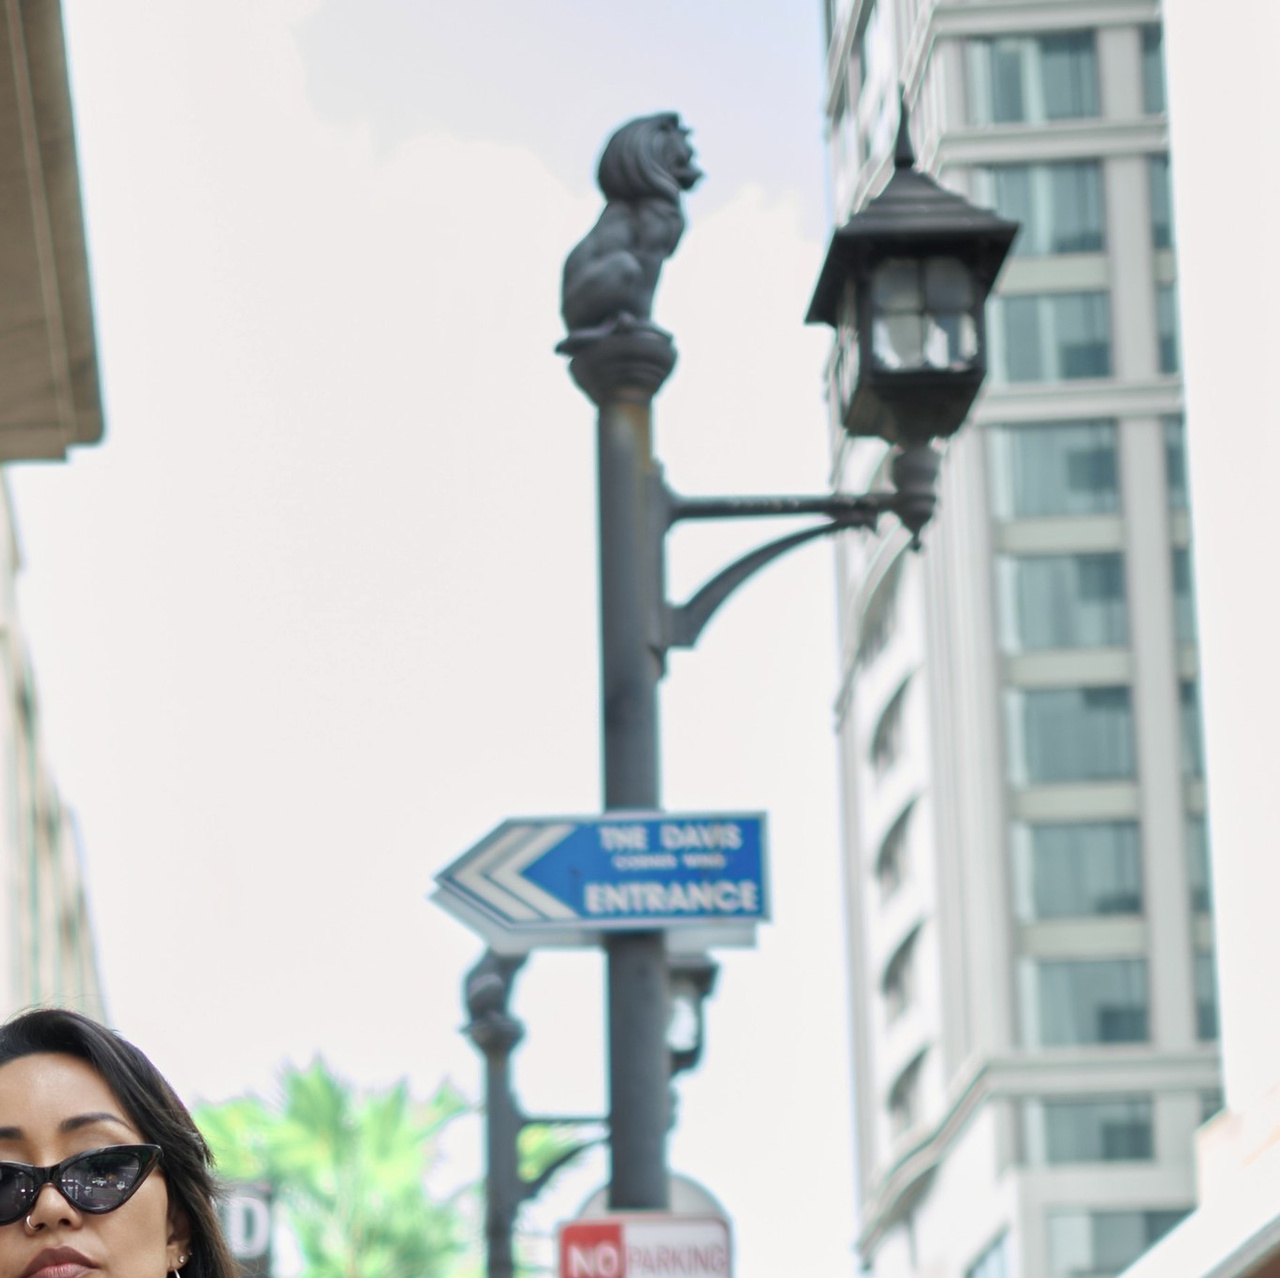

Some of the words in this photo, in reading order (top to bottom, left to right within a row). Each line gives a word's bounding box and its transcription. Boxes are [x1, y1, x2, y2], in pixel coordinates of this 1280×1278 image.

[600, 825, 648, 850] THE
[660, 823, 742, 849] DAVIS
[583, 880, 758, 913] ENTRANCE
[568, 1241, 619, 1278] NO
[628, 1244, 726, 1276] PARKING
